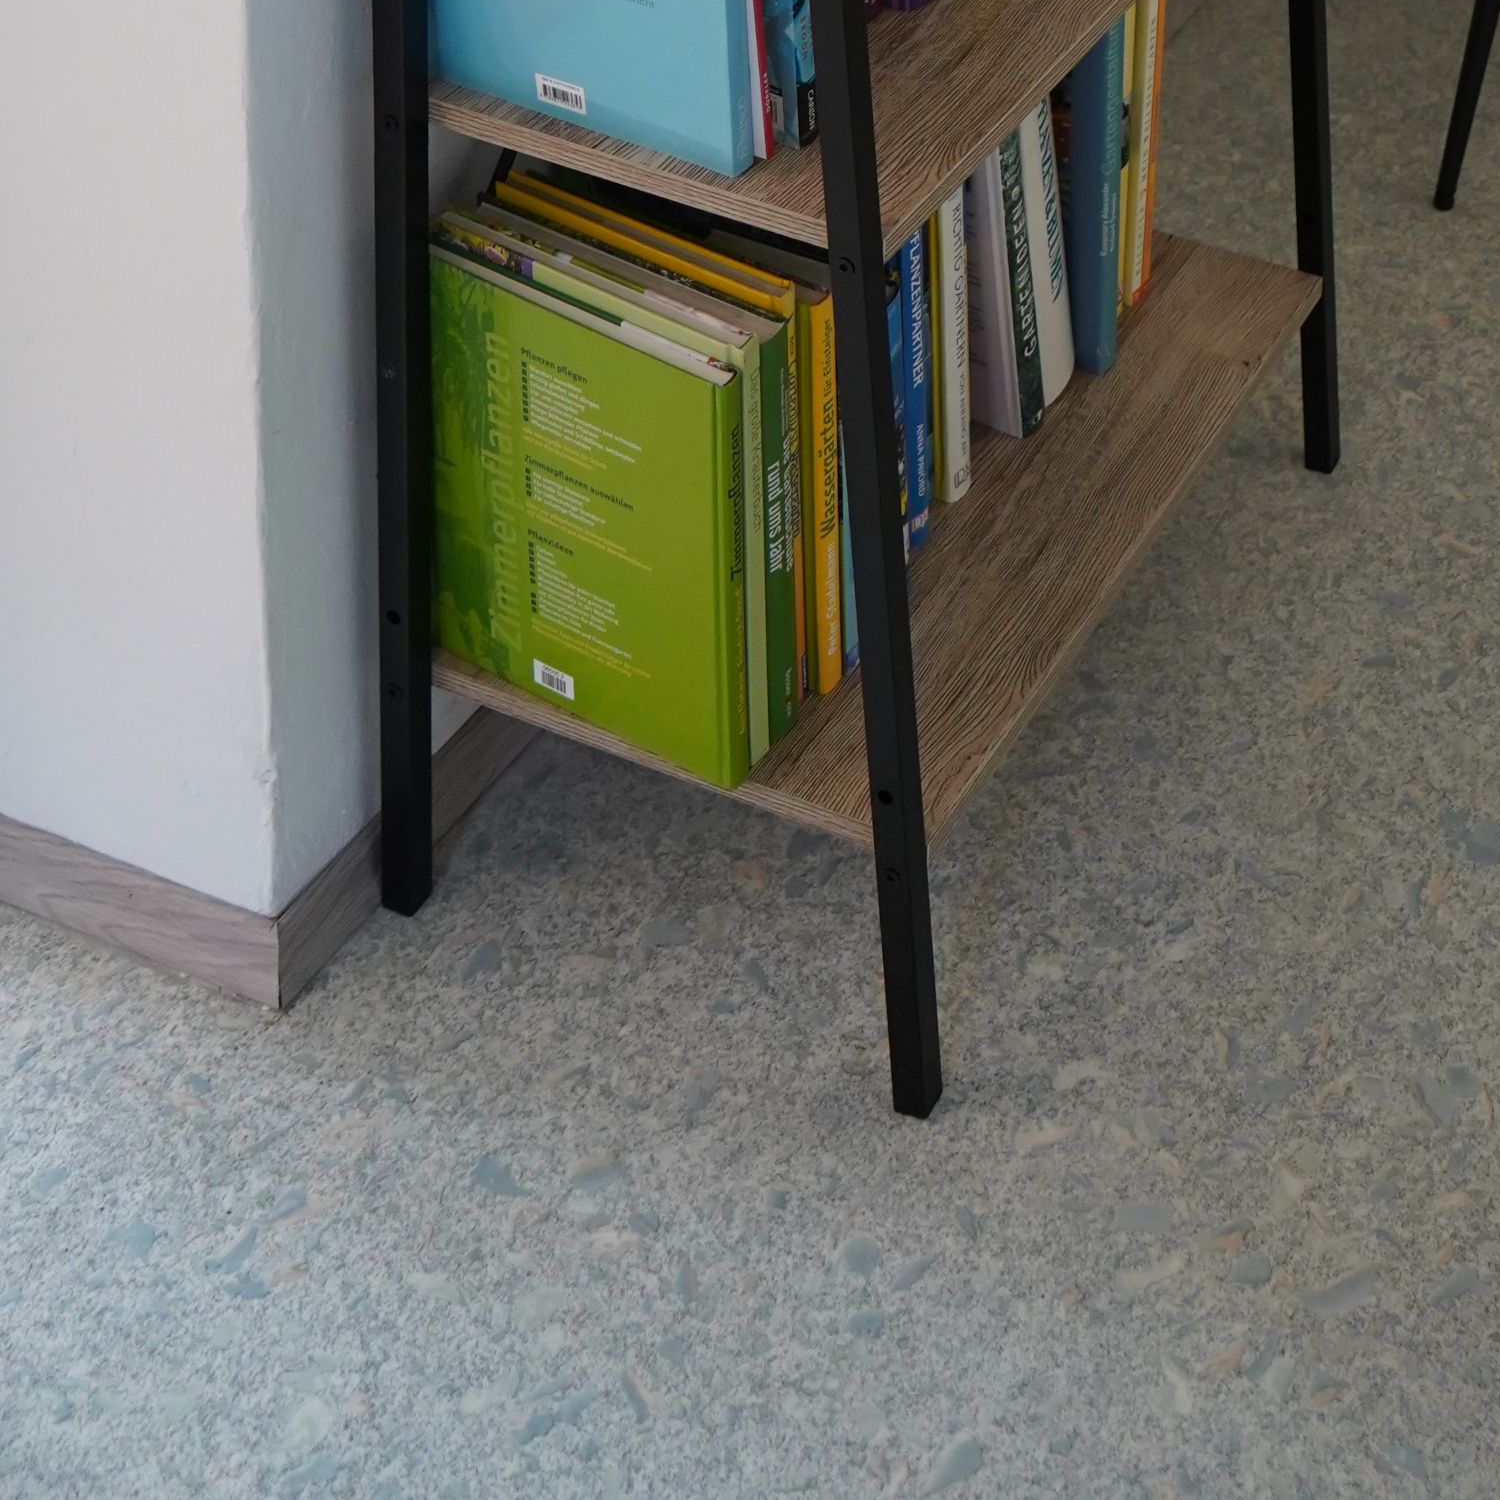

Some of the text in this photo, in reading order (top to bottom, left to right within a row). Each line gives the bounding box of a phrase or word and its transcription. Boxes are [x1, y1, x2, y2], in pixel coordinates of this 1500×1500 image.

[950, 203, 965, 272] RICHTIG
[520, 345, 588, 387] Pflanzen pflegen
[909, 229, 924, 389] FLANZENPARTNER
[523, 451, 589, 493] Zimmerpflanzen
[589, 483, 634, 513] auswählen
[817, 317, 838, 540] Wassergärten für Einsteiger
[481, 331, 523, 653] Zimmerpflanzen
[527, 526, 574, 558] Pflanzideen
[727, 423, 745, 581] Zimmerpflanzen
[766, 460, 786, 574] rund ums Jahr
